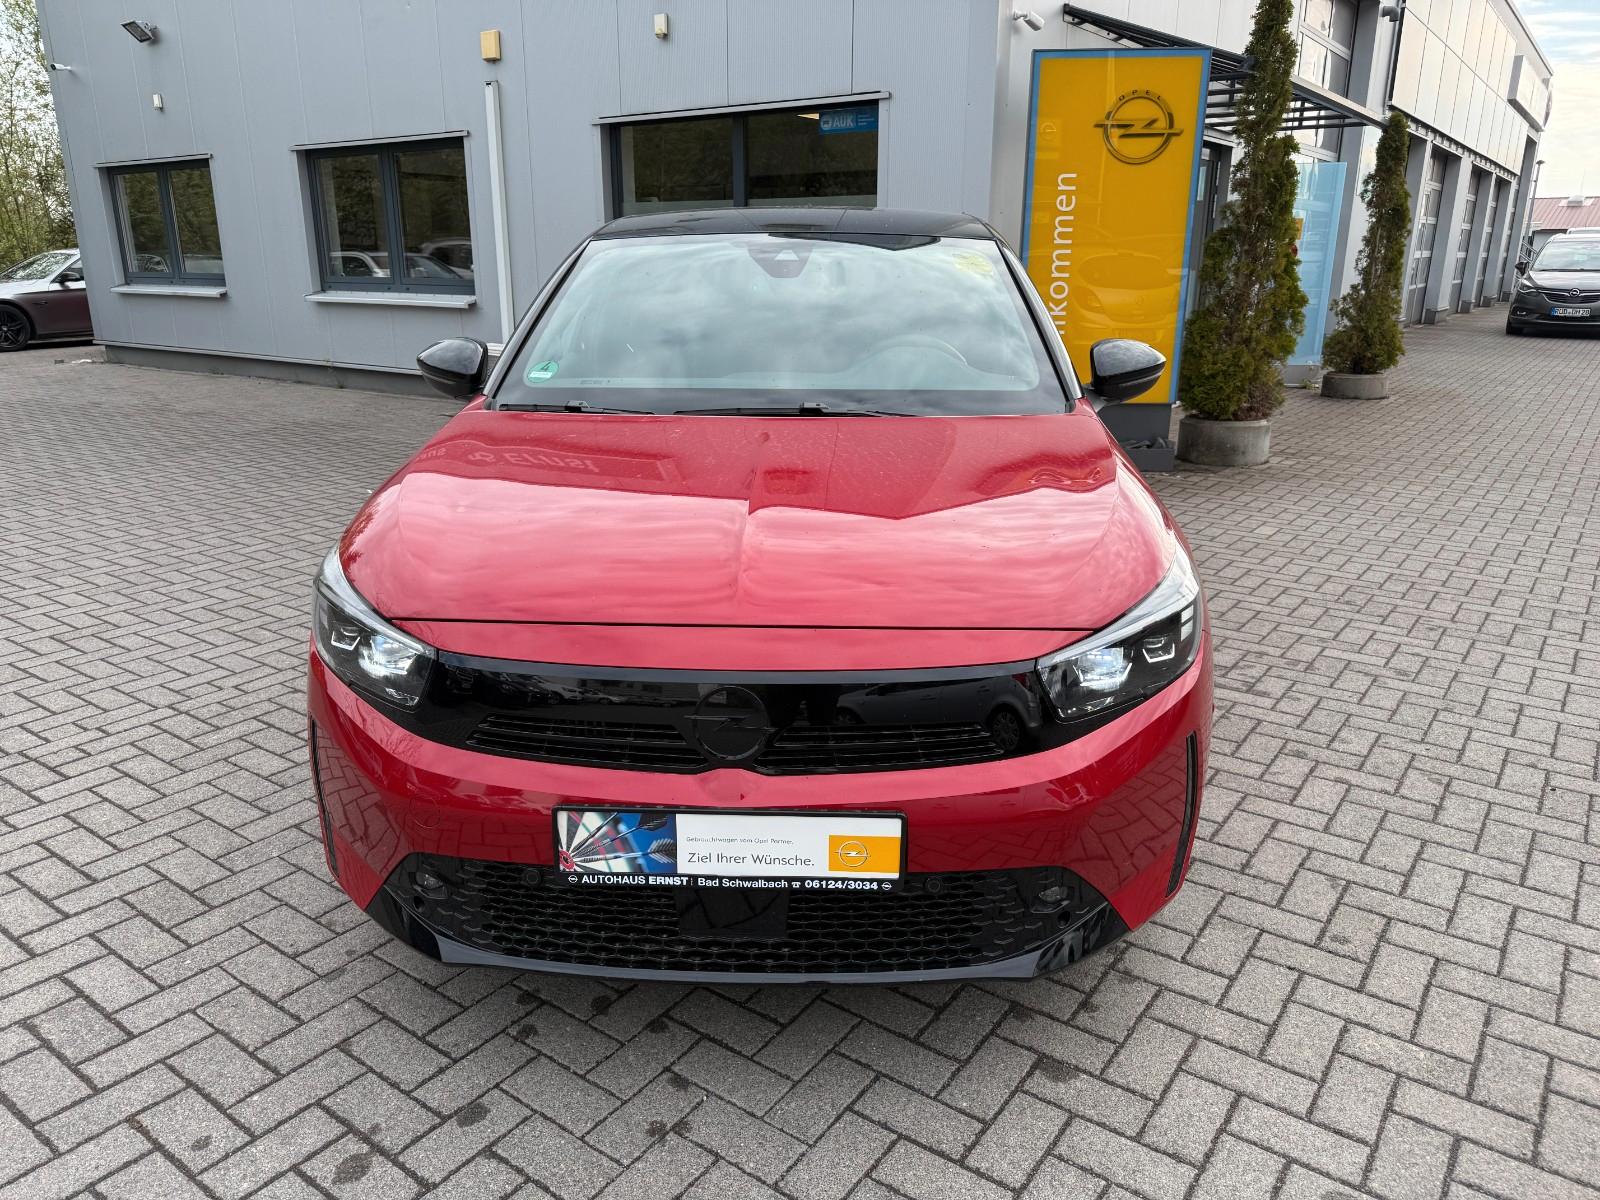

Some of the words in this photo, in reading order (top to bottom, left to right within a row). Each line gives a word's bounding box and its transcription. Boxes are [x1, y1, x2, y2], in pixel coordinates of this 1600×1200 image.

[1050, 172, 1078, 335] kommen
[540, 360, 552, 372] 4
[687, 852, 712, 864] Ziel
[716, 852, 748, 865] Ihrer
[751, 853, 815, 867] Wünsche.
[581, 875, 646, 885] AUTOHAUS
[648, 876, 689, 887] ERNST
[697, 877, 719, 887] Bad
[722, 878, 788, 889] Schwalbach
[804, 879, 879, 890] 06124/3034
